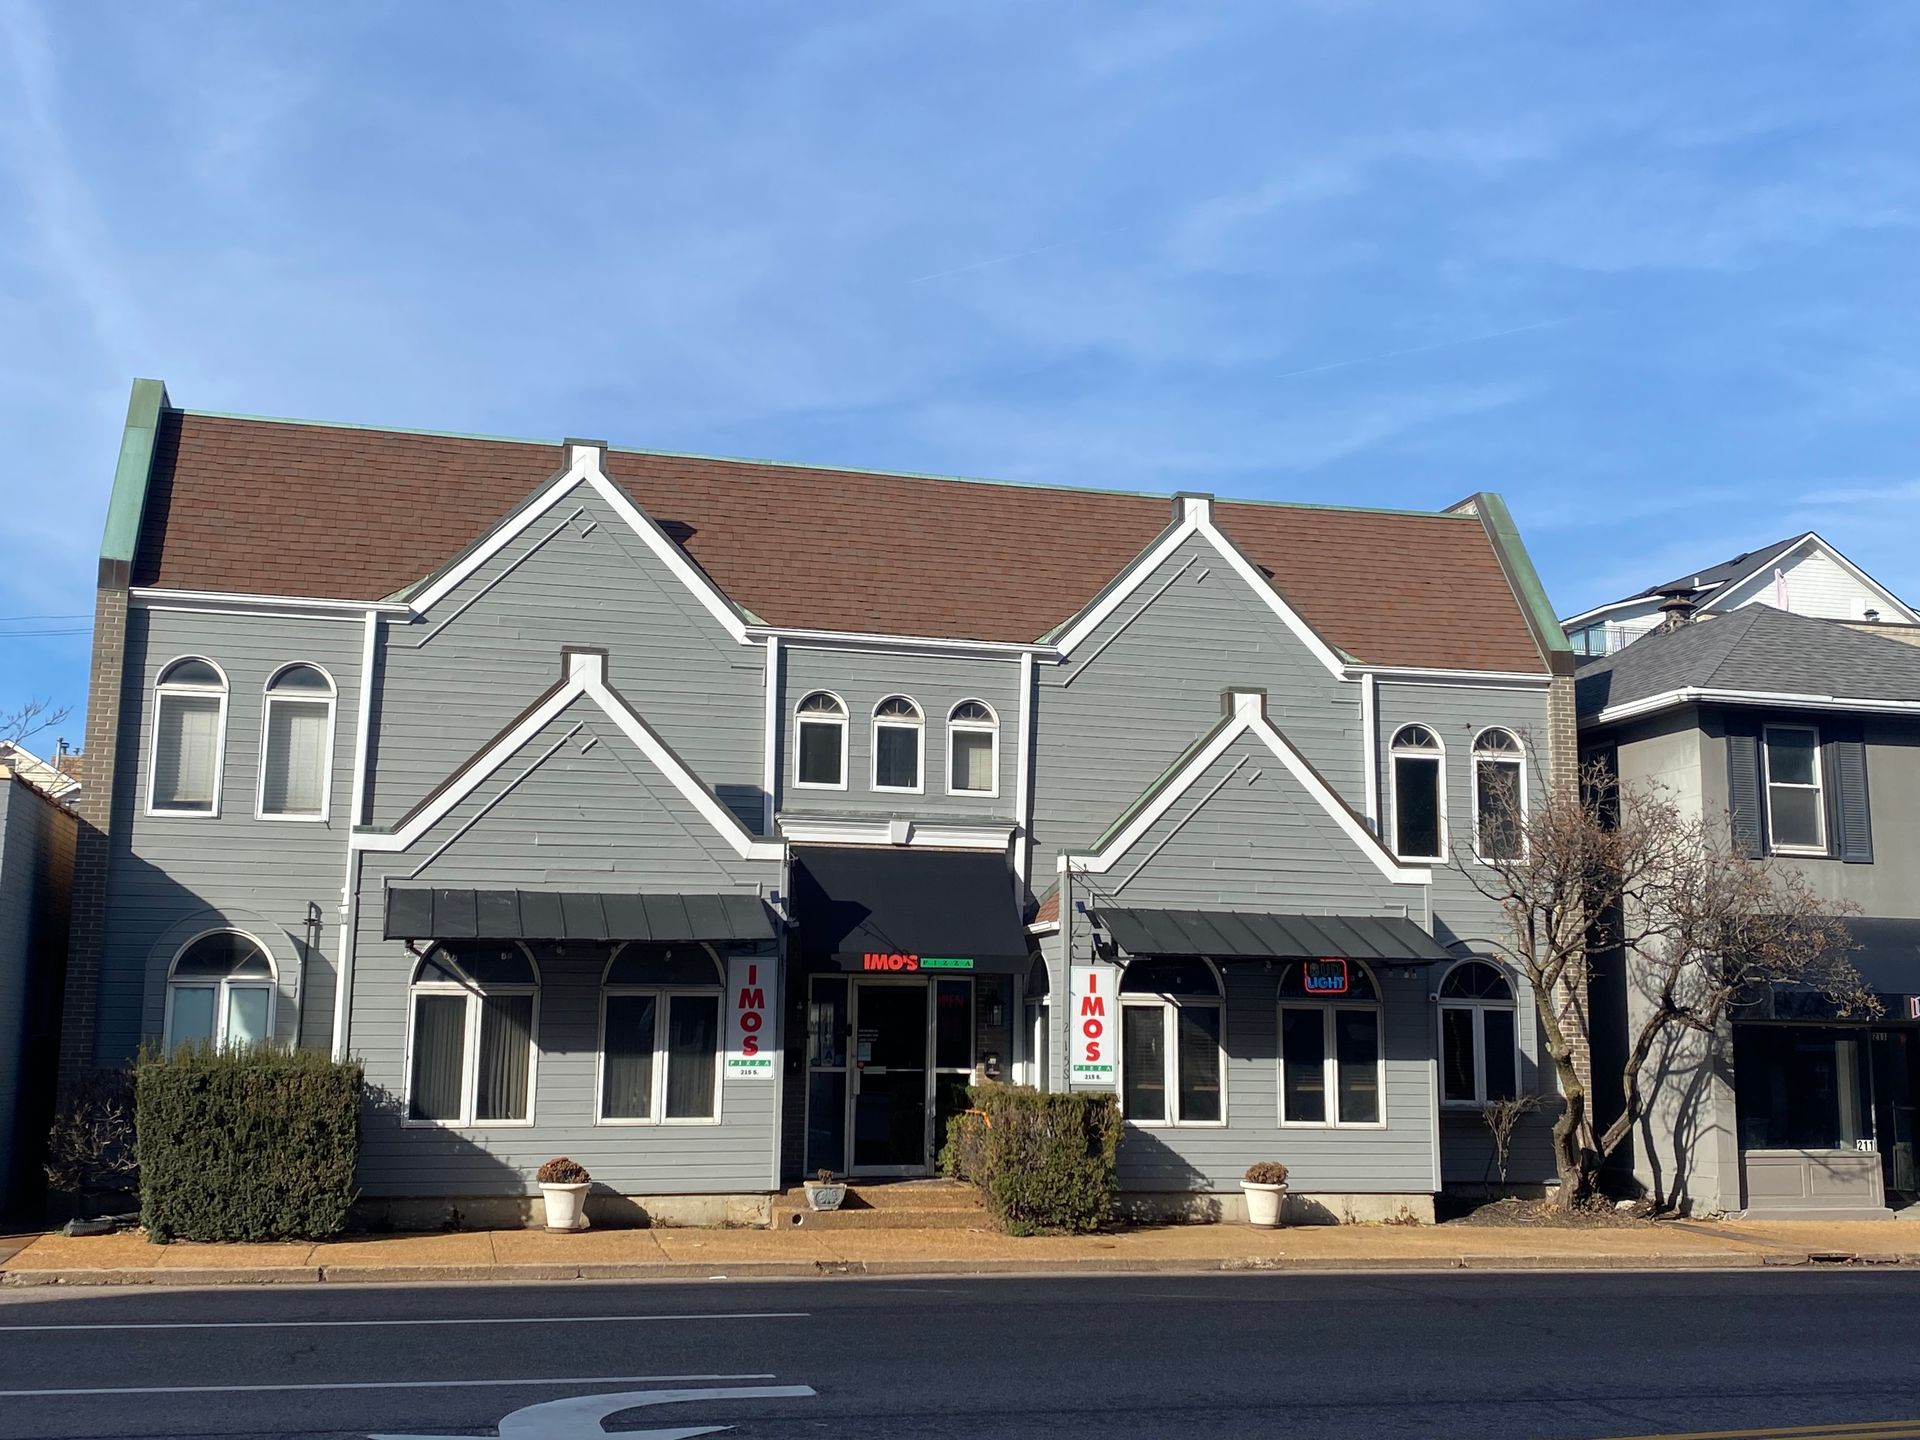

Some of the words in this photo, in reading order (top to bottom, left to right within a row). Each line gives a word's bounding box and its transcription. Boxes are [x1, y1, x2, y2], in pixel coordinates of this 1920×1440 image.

[863, 953, 918, 971] IMO'S
[1308, 976, 1344, 988] LIGHT
[738, 964, 765, 1057] IMOS
[1080, 974, 1105, 1062] IMOS
[1857, 1140, 1873, 1151] 211
